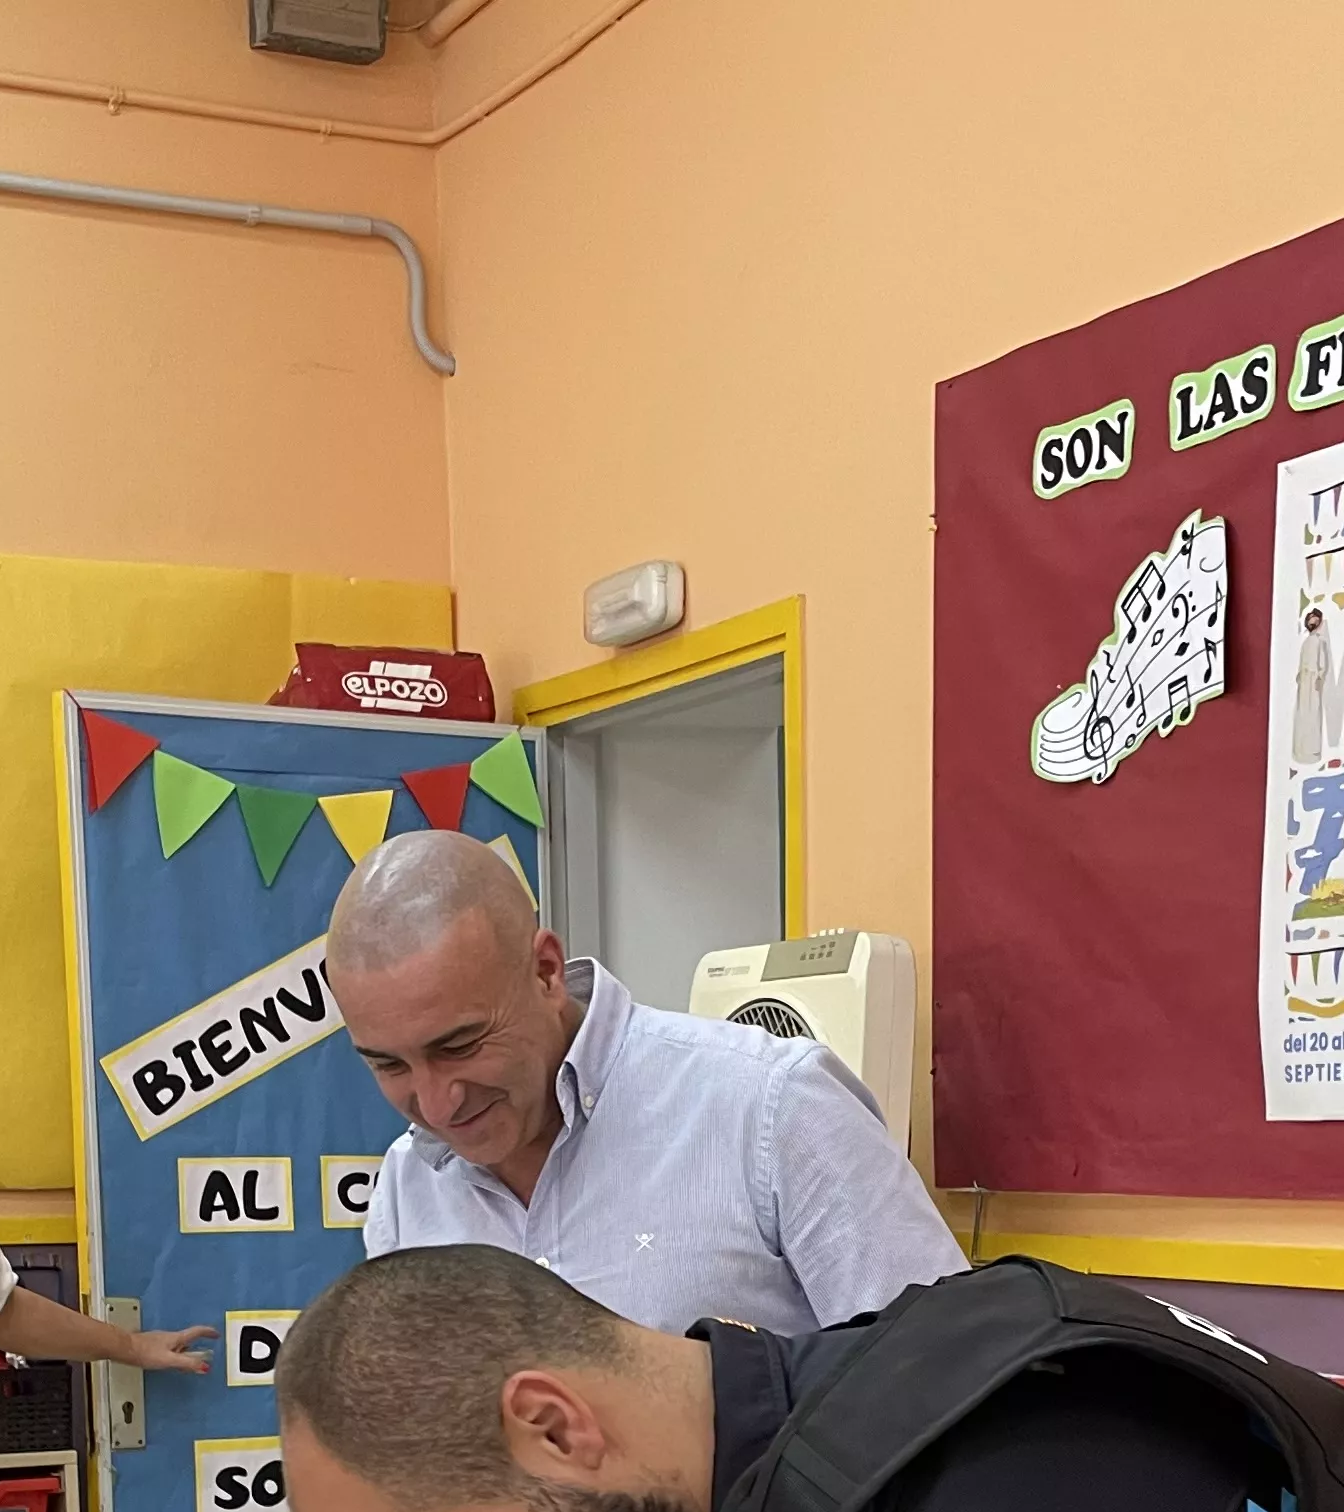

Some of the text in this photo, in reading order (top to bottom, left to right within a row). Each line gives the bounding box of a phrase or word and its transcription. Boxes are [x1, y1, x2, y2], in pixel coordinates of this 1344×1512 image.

[1039, 412, 1129, 489] SON
[1174, 356, 1270, 441] LAS
[131, 957, 332, 1117] BIENV
[1284, 1033, 1307, 1053] del
[1309, 1032, 1329, 1051] 20
[199, 1169, 380, 1223] AL C
[214, 1459, 287, 1510] SO
